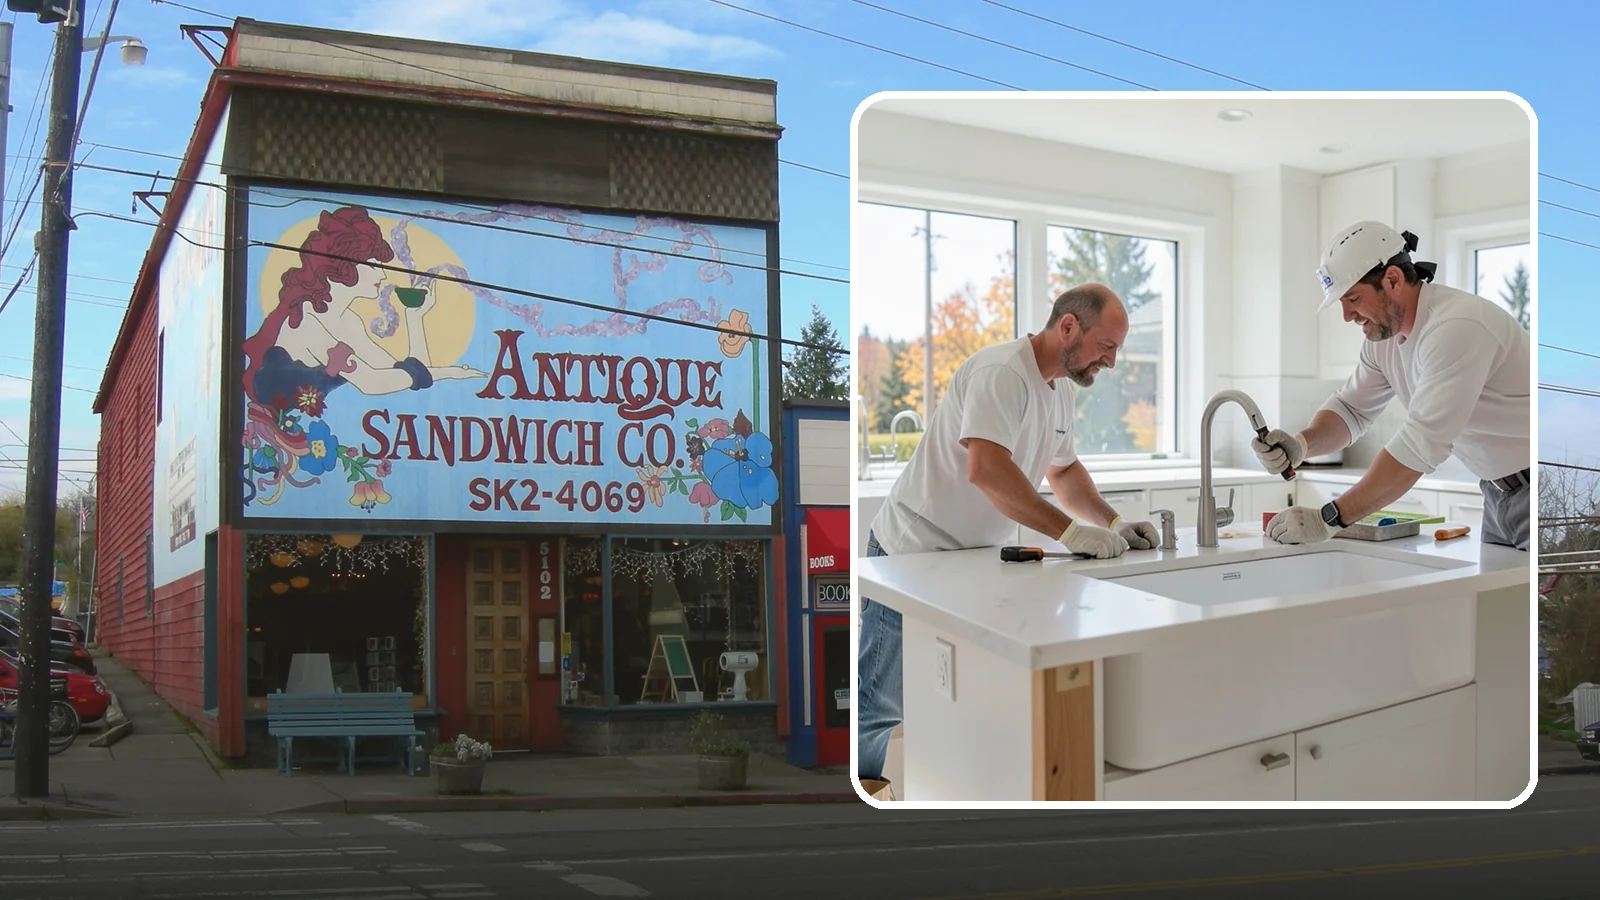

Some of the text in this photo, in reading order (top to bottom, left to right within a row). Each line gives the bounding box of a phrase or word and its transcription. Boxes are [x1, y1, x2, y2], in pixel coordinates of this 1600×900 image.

[476, 329, 723, 420] ANTIQUE
[362, 409, 684, 468] SANDWICH CO.
[468, 477, 645, 512] SK2-4069
[540, 541, 551, 600] 5102
[809, 555, 835, 569] BOOKS
